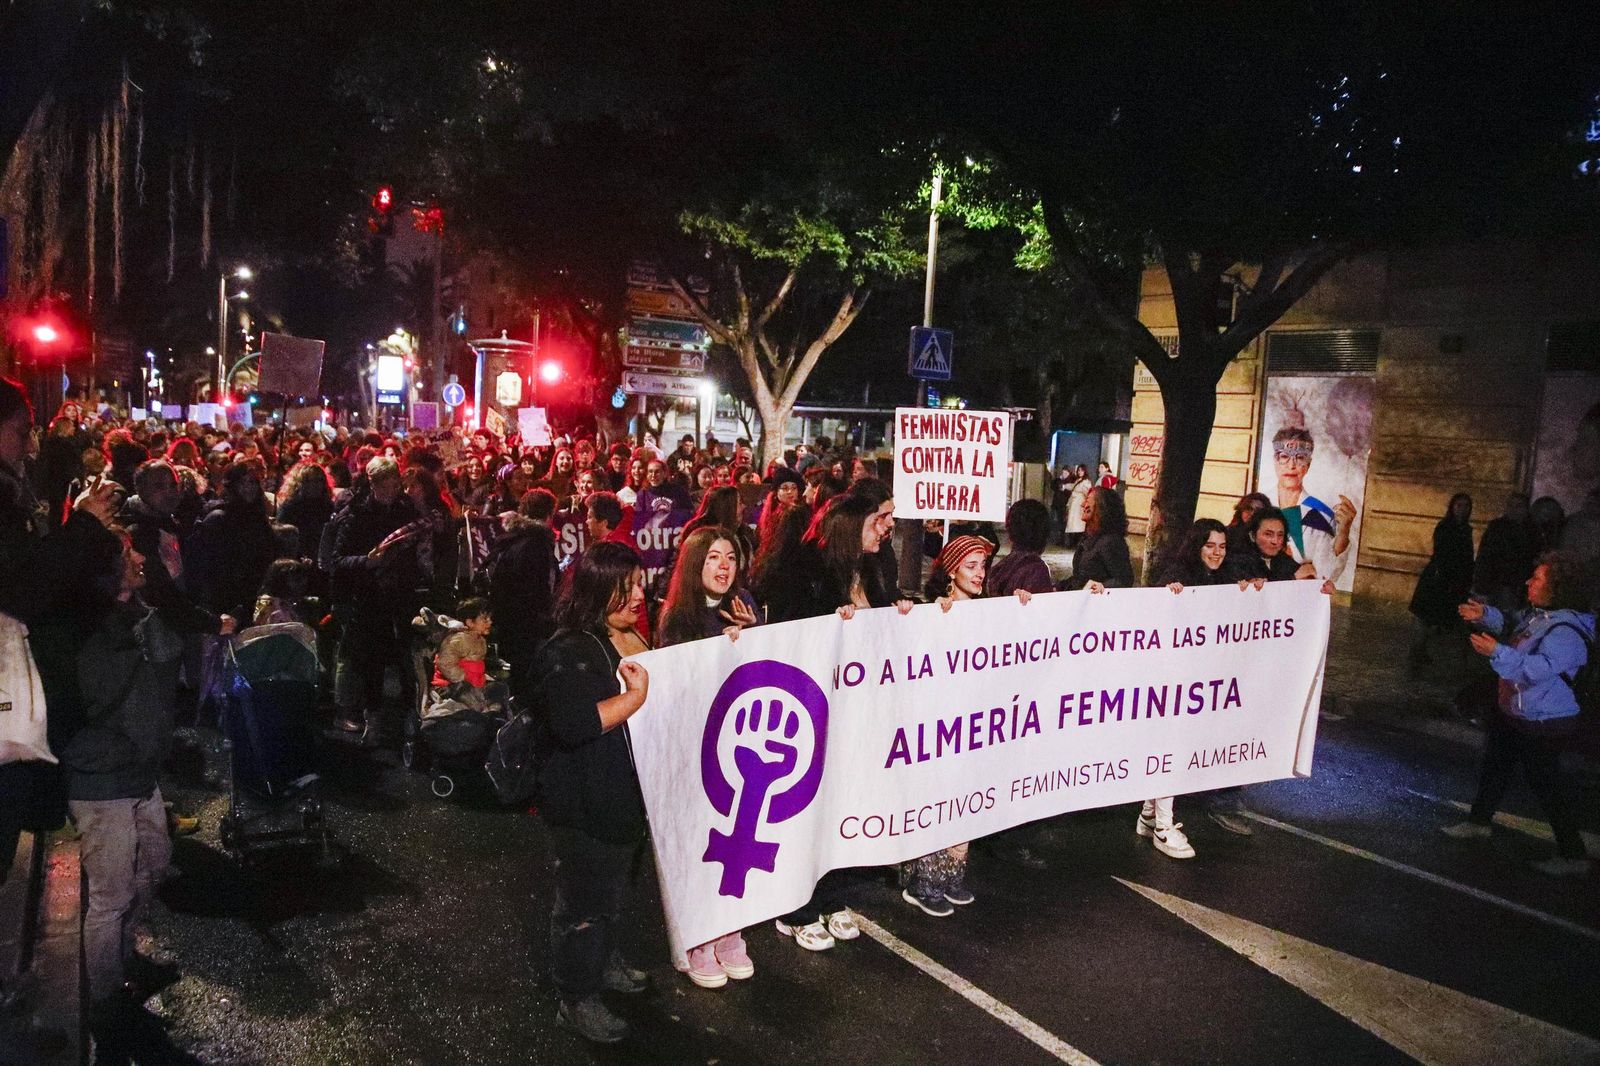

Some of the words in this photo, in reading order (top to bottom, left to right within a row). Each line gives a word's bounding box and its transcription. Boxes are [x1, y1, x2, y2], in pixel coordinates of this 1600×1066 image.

[900, 412, 1003, 446] FEMINISTAS
[901, 446, 965, 474] CONTRA
[971, 449, 995, 478] LA
[915, 481, 980, 513] GUERRA
[831, 661, 866, 692] NO
[879, 658, 896, 686] A
[907, 653, 934, 681] LA
[946, 636, 1061, 675] VIOLENCIA
[1068, 628, 1161, 656] CONTRA
[1172, 625, 1207, 649] LAS
[1216, 618, 1295, 645] MUJERES
[883, 694, 1042, 769] ALMERÍA
[1058, 676, 1242, 730] FEMINISTA
[839, 786, 997, 841] COLECTIVOS
[1010, 759, 1130, 803] FEMINISTAS
[1145, 753, 1174, 777] DE
[1187, 737, 1268, 772] ALMERÍA
